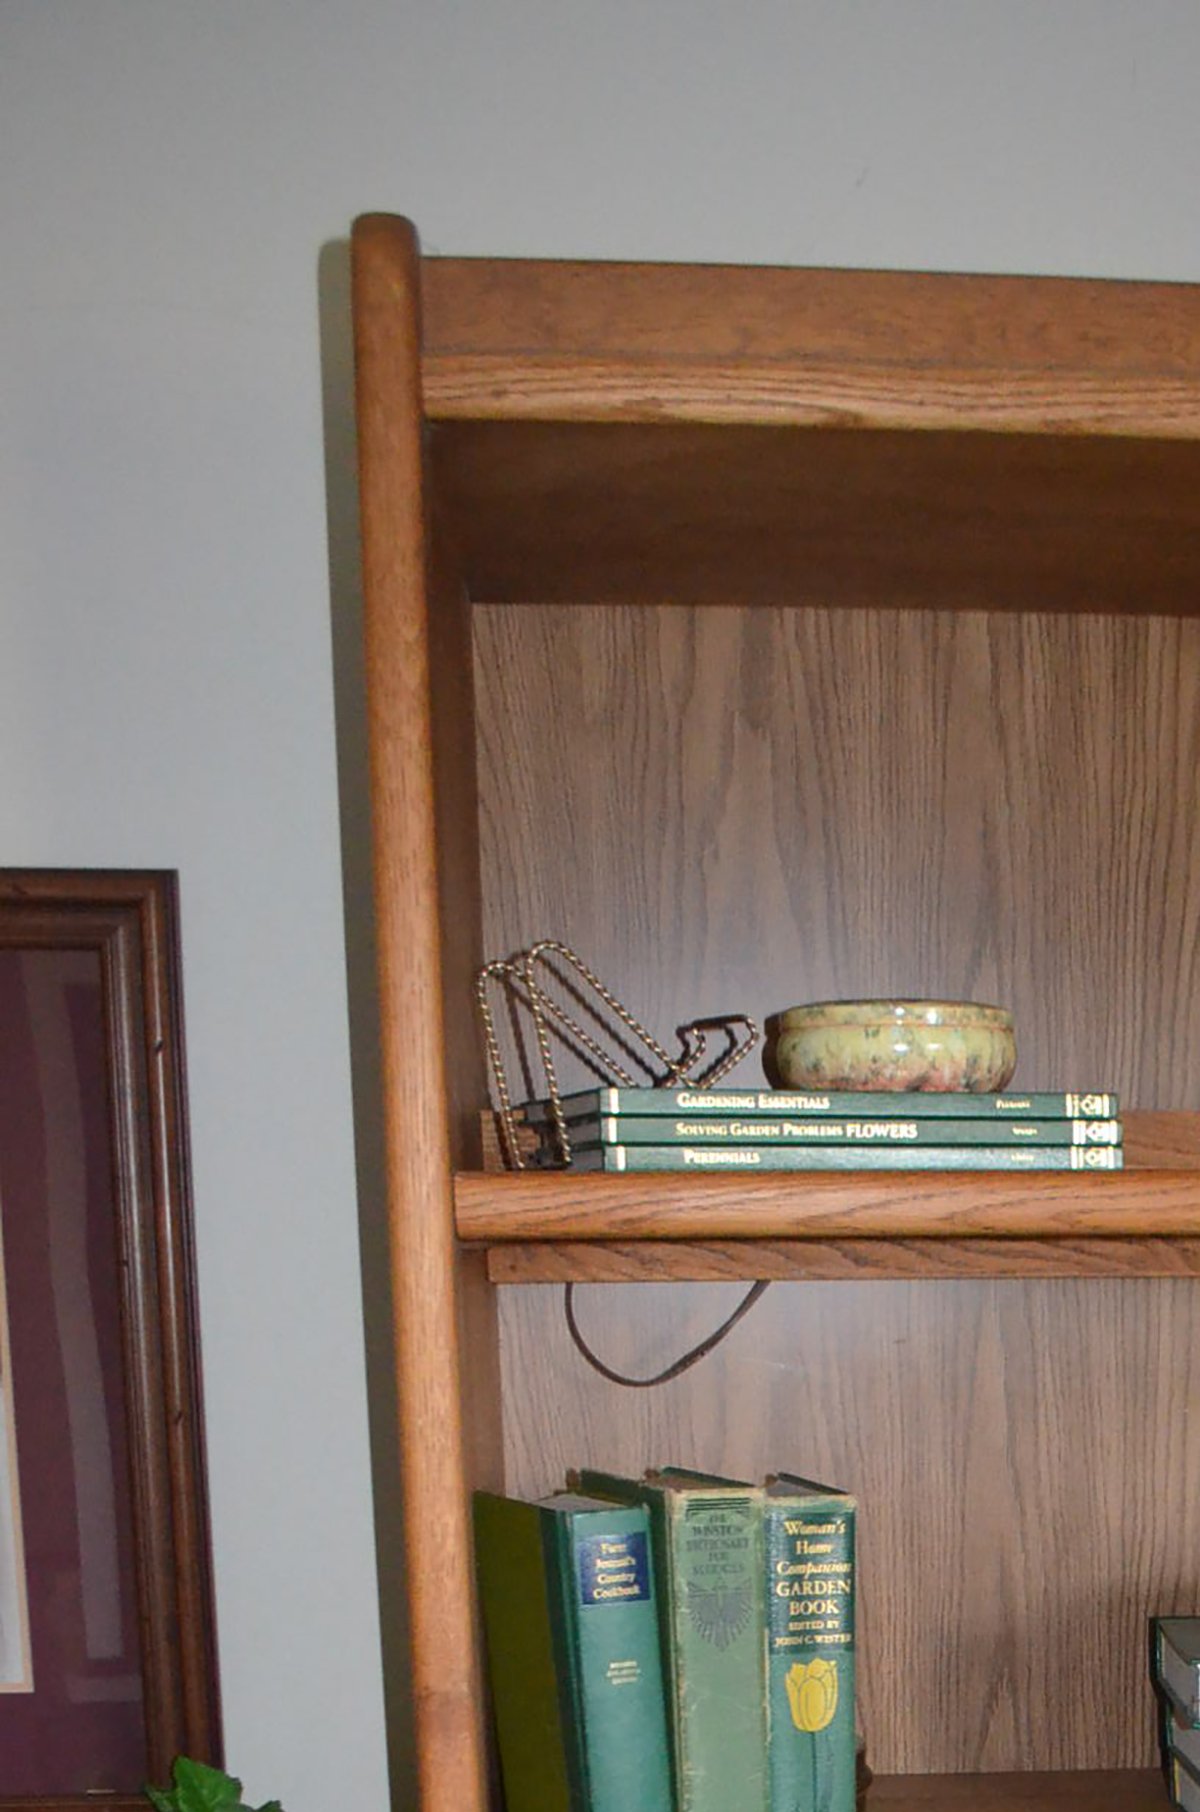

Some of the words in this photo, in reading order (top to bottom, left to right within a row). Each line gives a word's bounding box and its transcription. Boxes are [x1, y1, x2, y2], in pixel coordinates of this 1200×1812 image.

[846, 1123, 917, 1139] FLOWERS
[784, 1520, 846, 1536] Woman's
[795, 1540, 833, 1555] Home
[776, 1560, 852, 1580] Companion
[776, 1579, 851, 1597] GARDEN
[789, 1600, 840, 1616] BOOK
